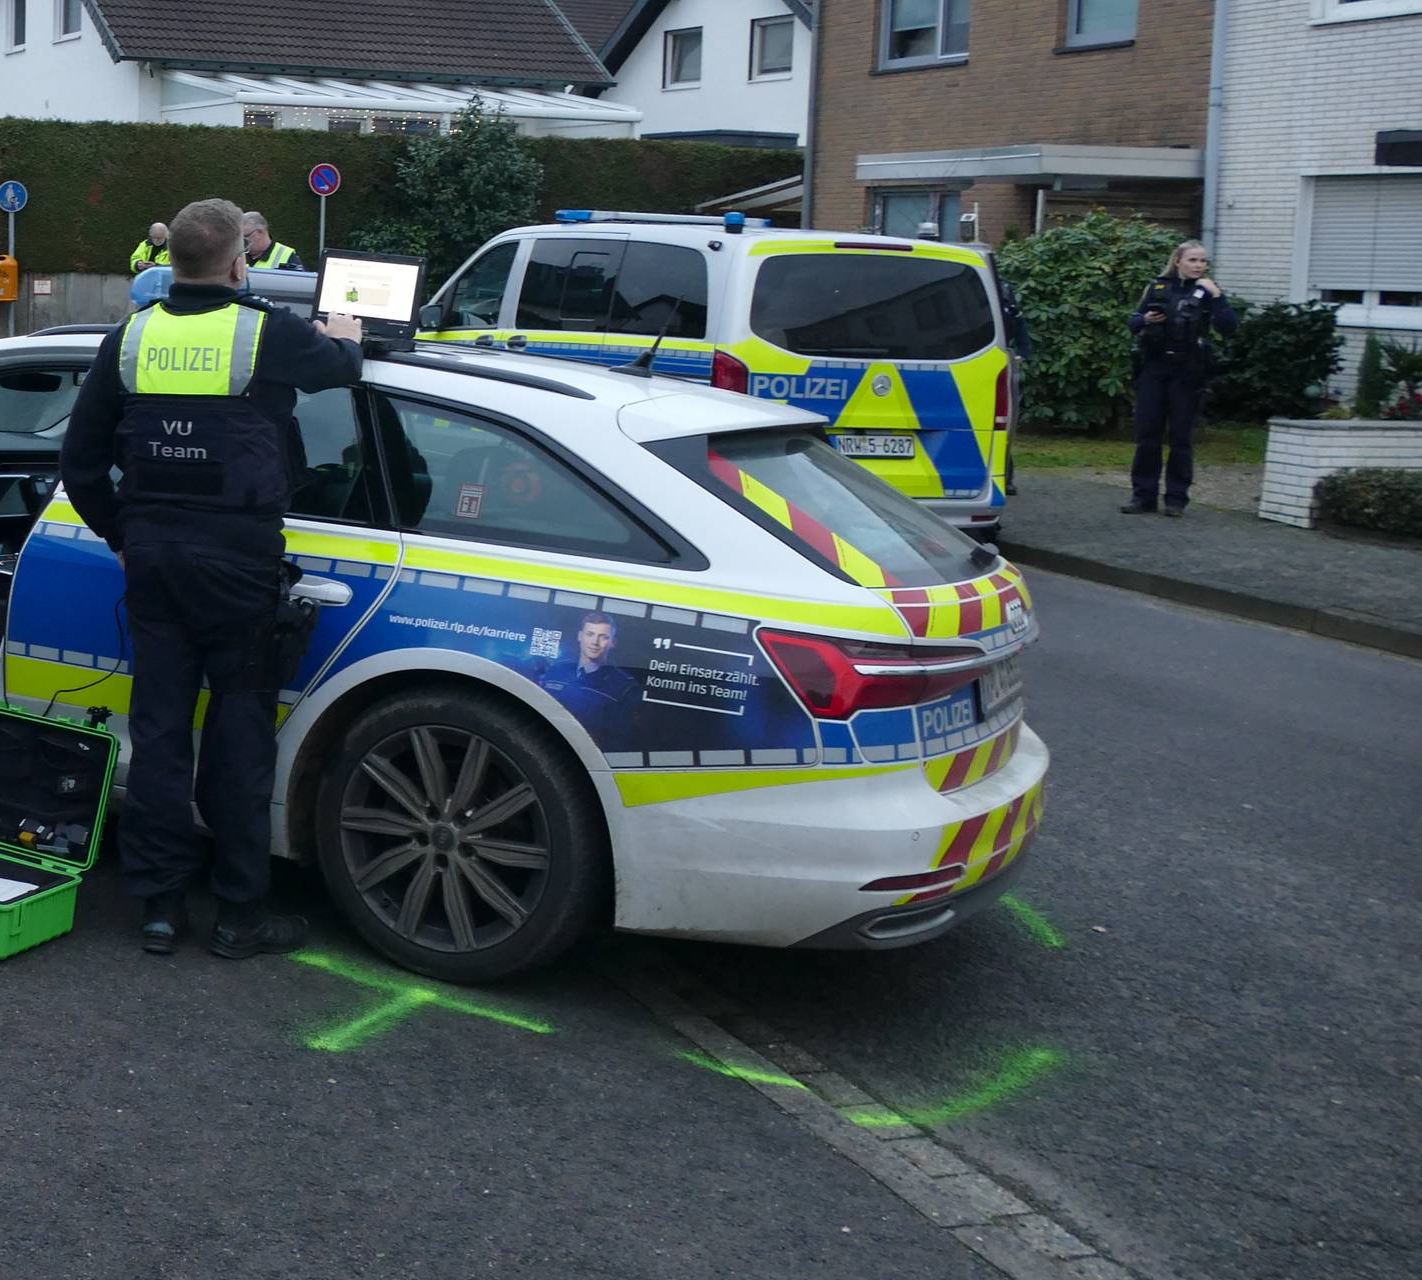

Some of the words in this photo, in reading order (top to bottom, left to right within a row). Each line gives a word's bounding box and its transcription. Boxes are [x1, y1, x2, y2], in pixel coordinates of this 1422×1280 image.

[145, 346, 220, 372] POLIZEI
[753, 375, 848, 400] POLIZEI
[162, 419, 192, 436] VU
[148, 440, 207, 460] Team
[868, 438, 912, 454] 5-6287
[389, 614, 527, 642] www.polizei.rlp.de/karriere
[649, 659, 678, 674] Dein
[679, 663, 724, 682] Einsatz
[724, 670, 761, 687] zählt.
[645, 675, 686, 692] Komm
[688, 680, 707, 695] ins
[709, 684, 748, 701] Team!
[922, 699, 974, 738] POLIZEI
